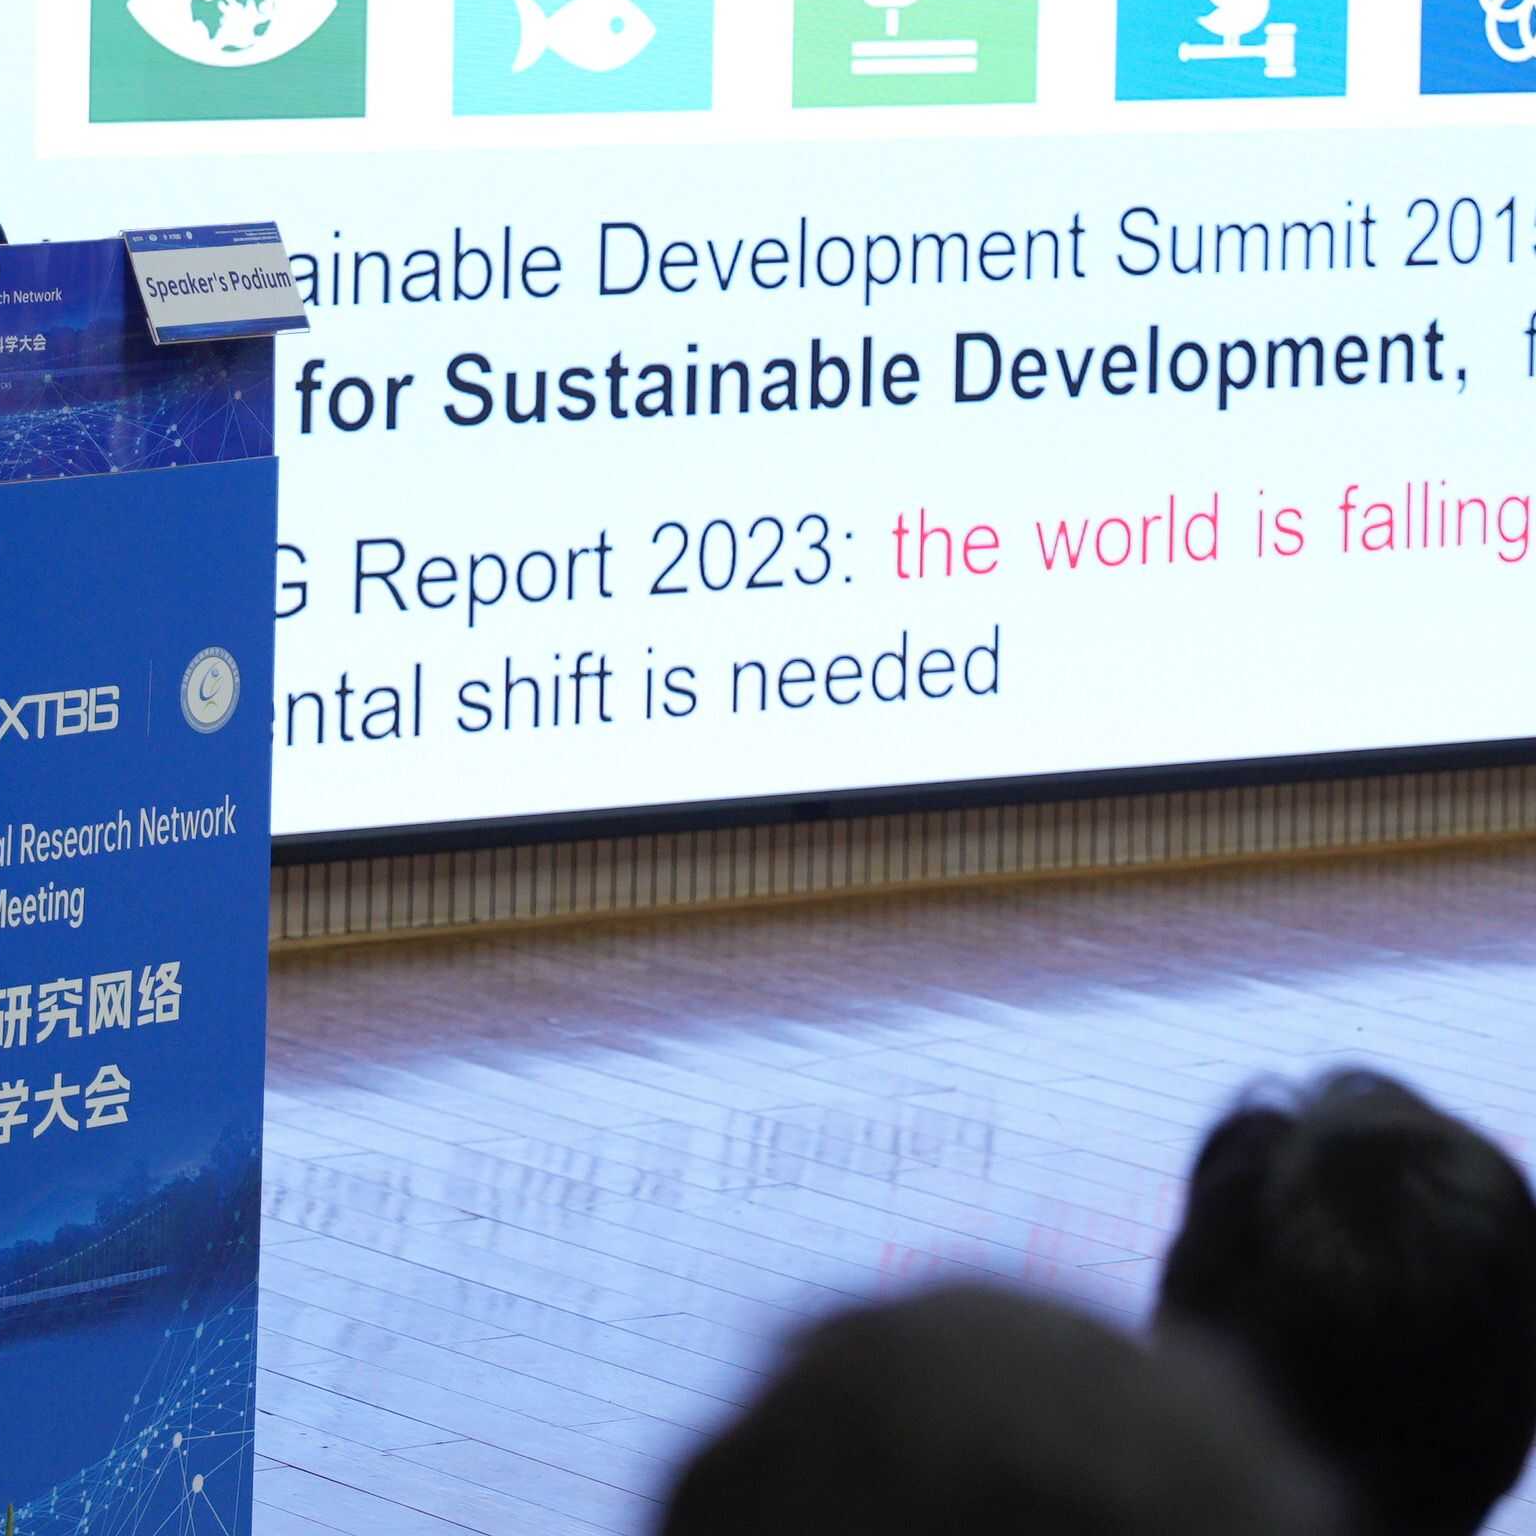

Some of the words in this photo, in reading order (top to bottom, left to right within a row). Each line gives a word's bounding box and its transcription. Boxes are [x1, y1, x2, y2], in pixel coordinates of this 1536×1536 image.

[14, 288, 62, 304] Network
[146, 272, 228, 302] Speaker's
[229, 267, 292, 292] Podium
[600, 213, 1085, 306] Development
[1118, 201, 1376, 276] Summit
[295, 359, 414, 434] for
[444, 336, 920, 426] Sustainable
[955, 319, 1465, 411] Development,
[354, 529, 613, 628] Report
[649, 513, 852, 595] 2023:
[892, 508, 999, 579] the
[1036, 492, 1218, 570] world
[1258, 490, 1304, 557] is
[1339, 480, 1529, 563] falling
[457, 652, 612, 732] shift
[646, 648, 696, 719] is
[733, 624, 999, 712] needed
[20, 809, 131, 864] Research
[139, 794, 236, 847] Network
